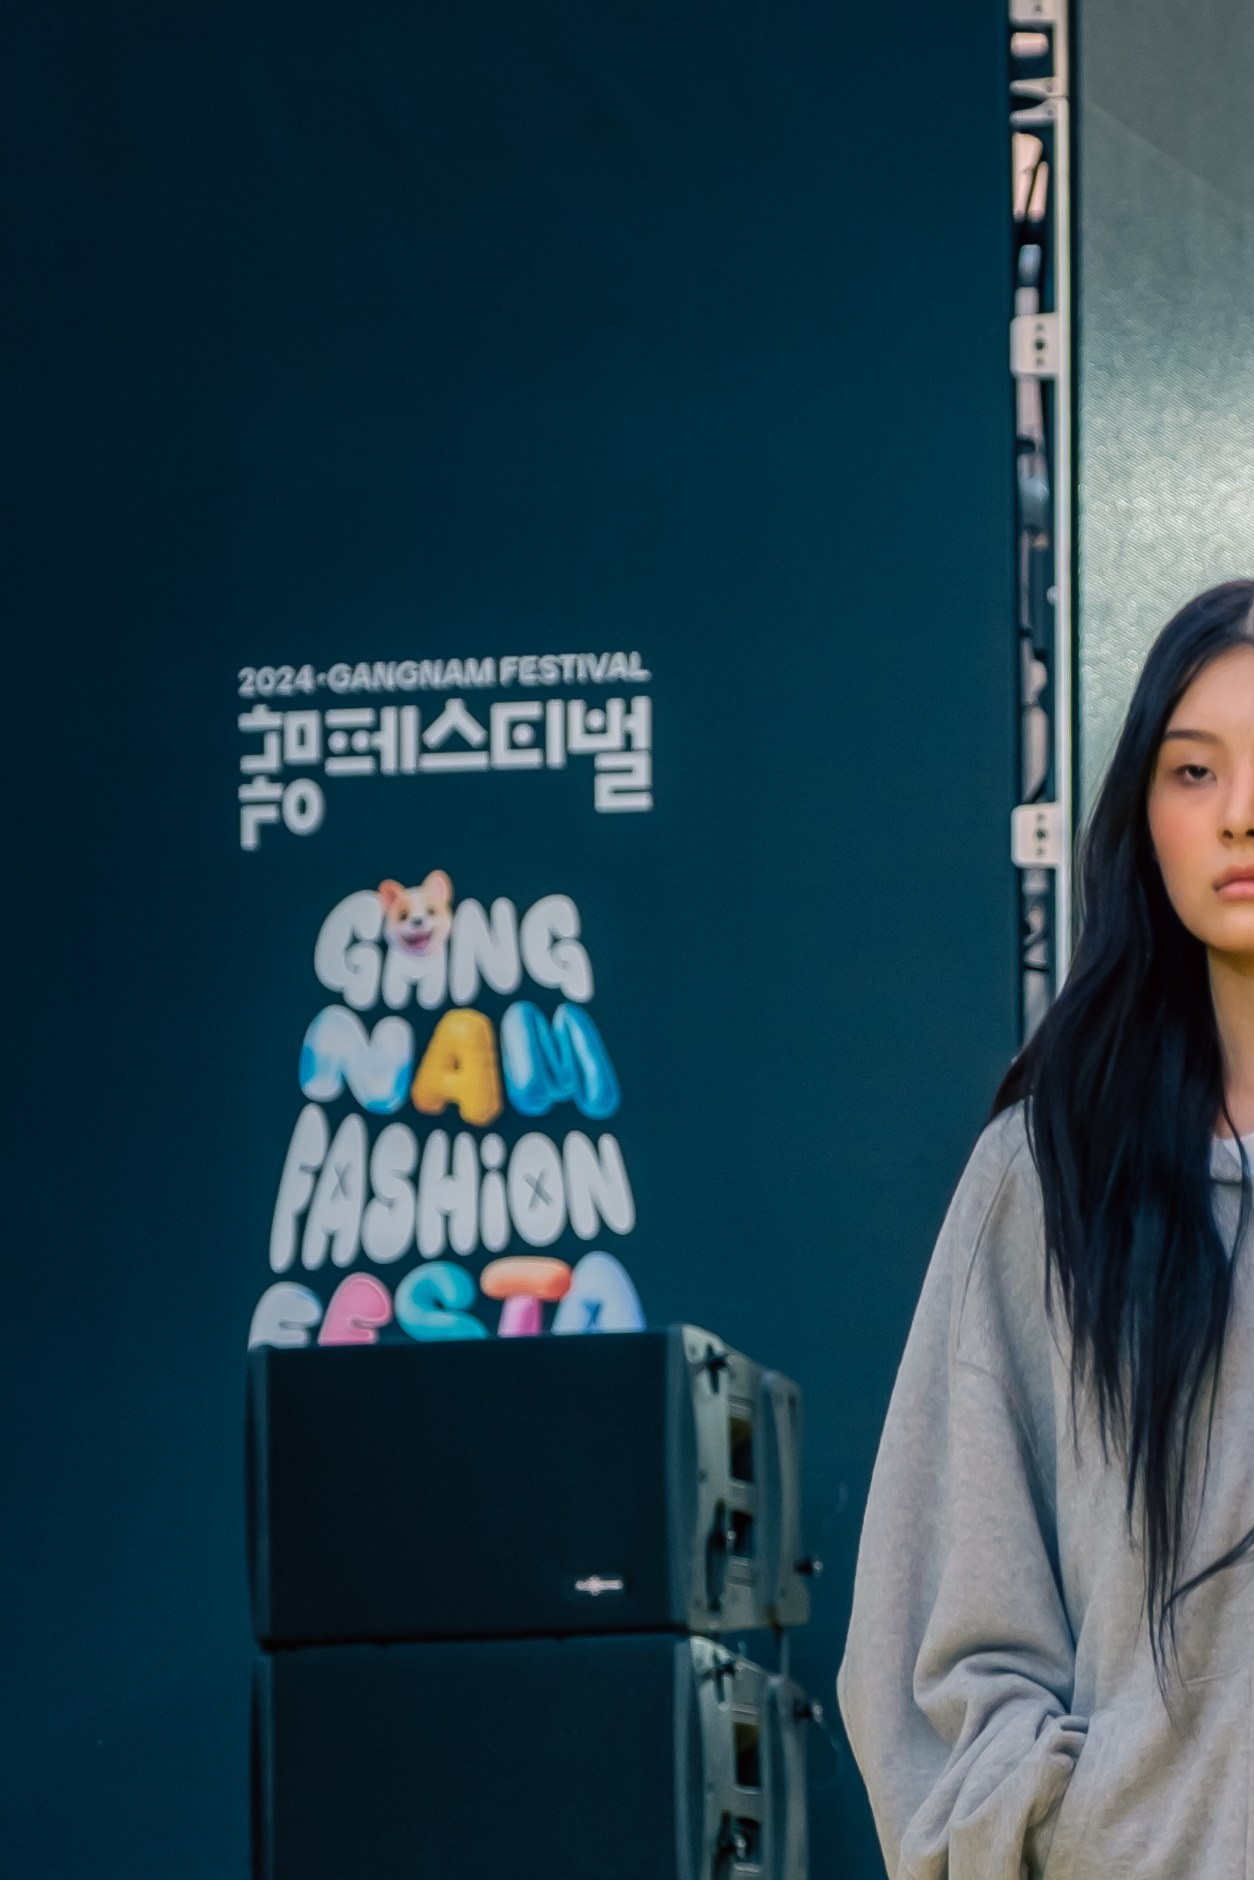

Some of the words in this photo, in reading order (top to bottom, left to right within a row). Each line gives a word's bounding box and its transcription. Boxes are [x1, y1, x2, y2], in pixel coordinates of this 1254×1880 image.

[500, 651, 652, 686] FESTIVAL
[313, 889, 596, 1010] GANG
[300, 1001, 621, 1126] NAM
